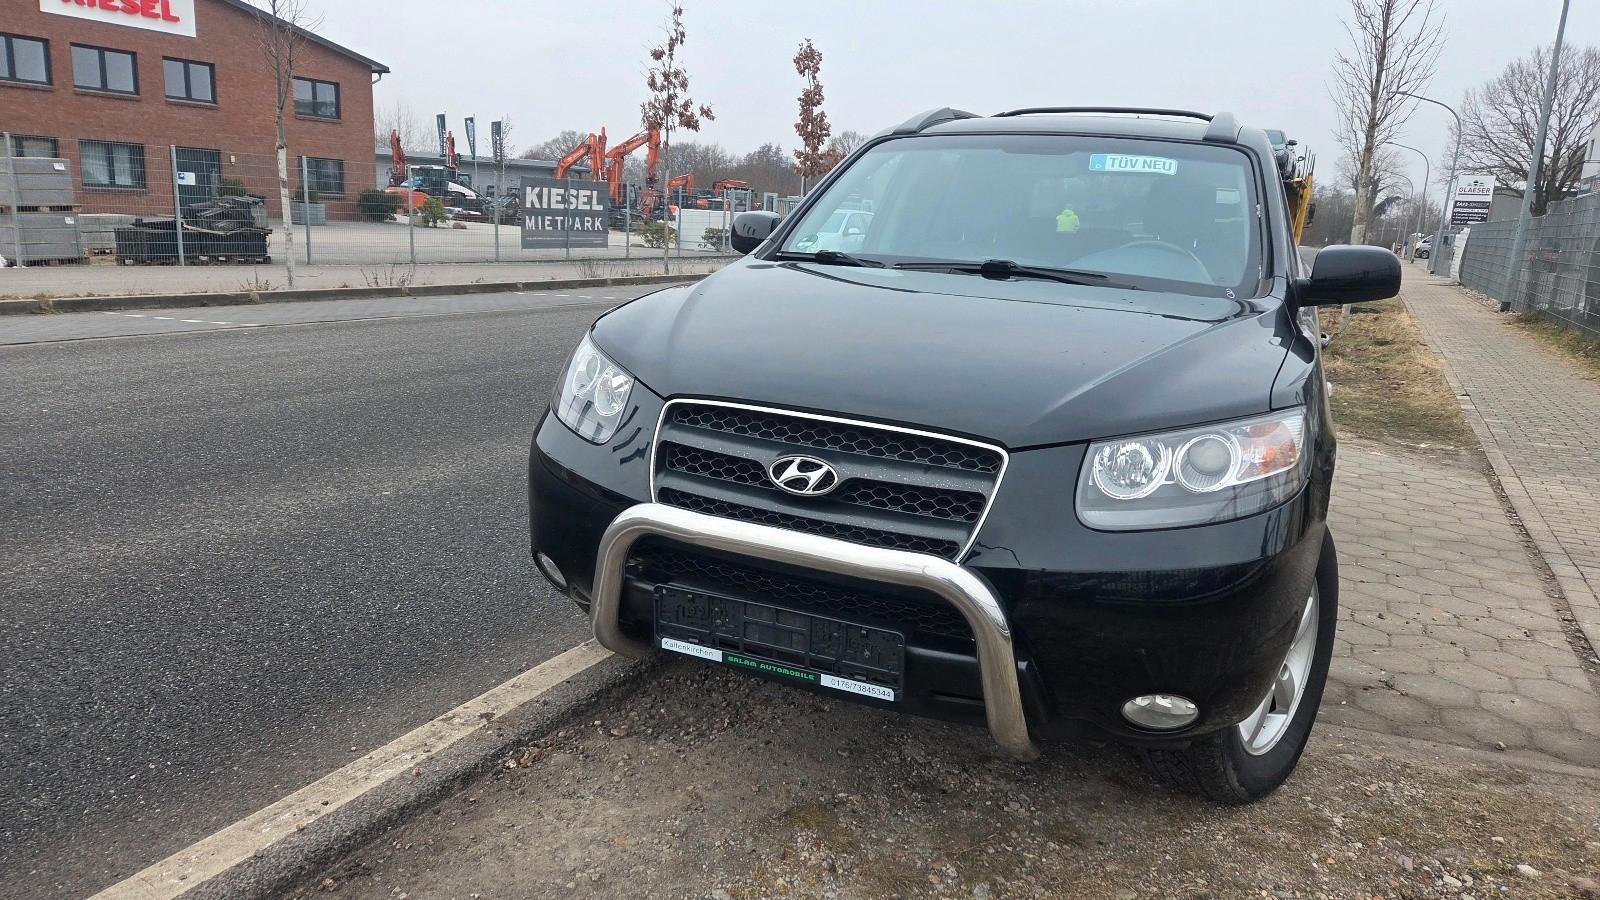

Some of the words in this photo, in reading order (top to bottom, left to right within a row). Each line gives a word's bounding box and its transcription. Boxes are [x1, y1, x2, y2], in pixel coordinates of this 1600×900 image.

[1109, 157, 1139, 169] TÜV
[1142, 159, 1173, 171] NEU
[525, 186, 604, 211] KIESEL
[525, 215, 603, 231] MIETPARK
[727, 655, 757, 668] SALAM
[759, 663, 816, 681] AUTOMOBILE
